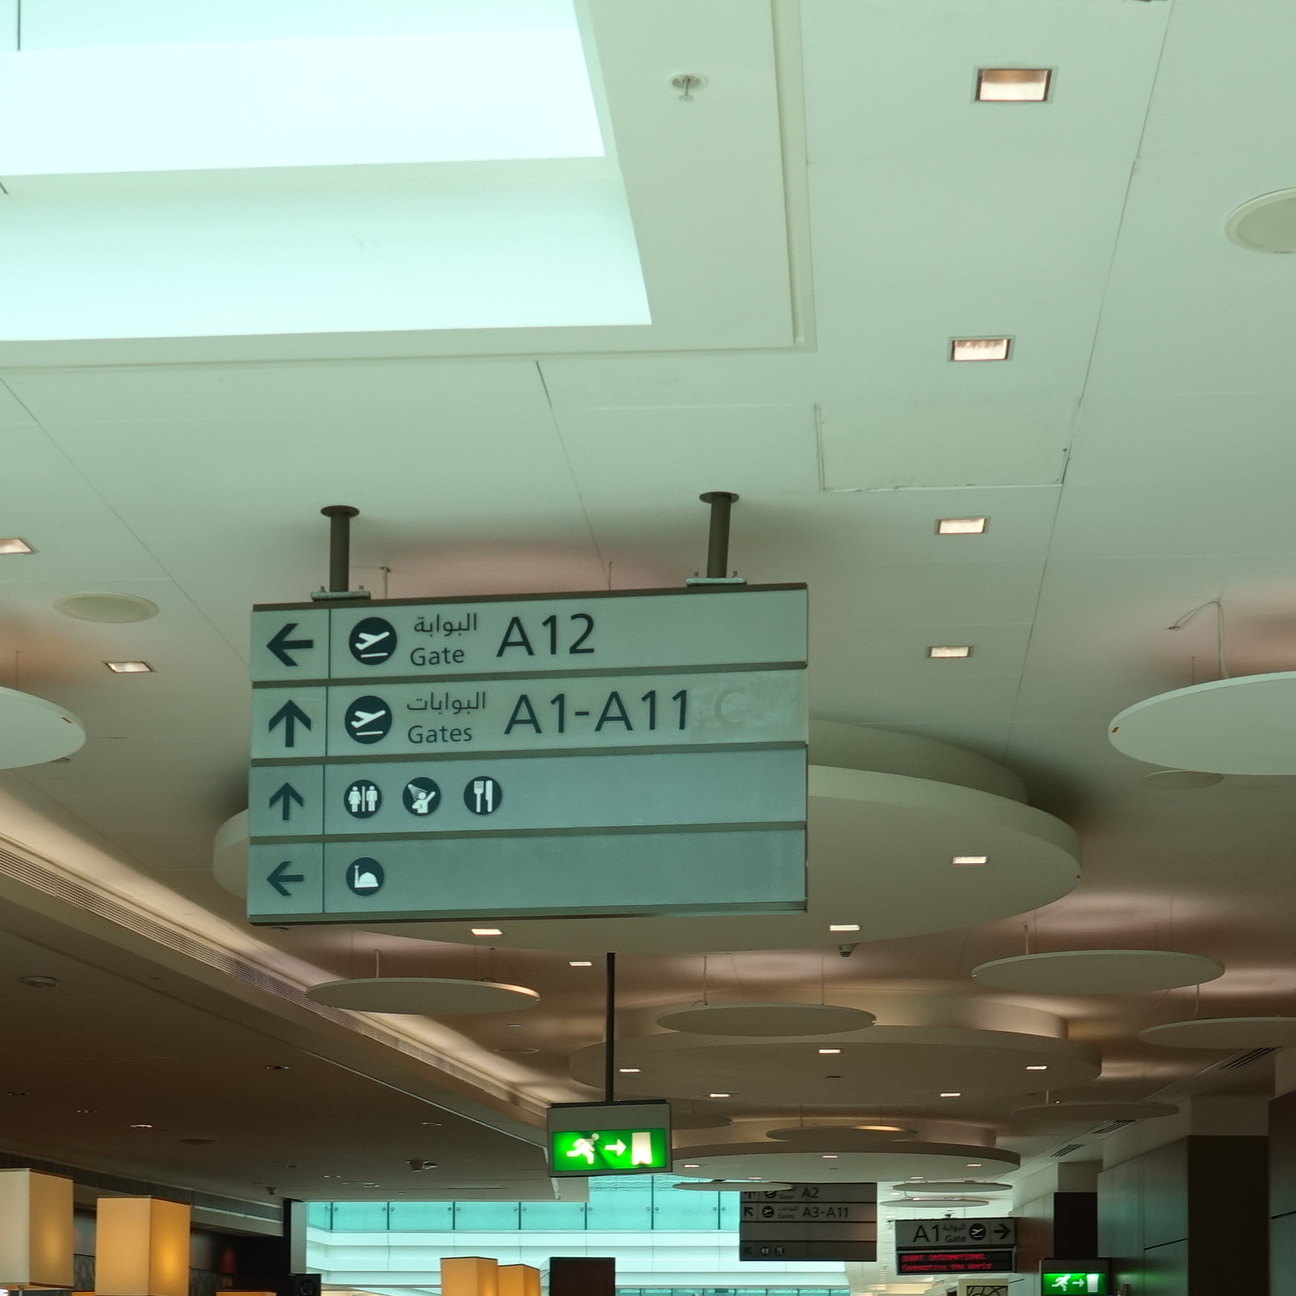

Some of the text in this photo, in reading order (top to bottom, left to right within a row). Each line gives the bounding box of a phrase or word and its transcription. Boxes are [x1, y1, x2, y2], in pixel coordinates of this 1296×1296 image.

[413, 613, 478, 637] البوابة
[410, 612, 595, 667] Gate A12
[406, 691, 486, 715] البوابات
[407, 724, 473, 744] Gates
[503, 689, 688, 735] A1-A11
[801, 1187, 819, 1199] A2
[801, 1206, 849, 1218] A3-A11
[912, 1224, 966, 1243] A1 Gate
